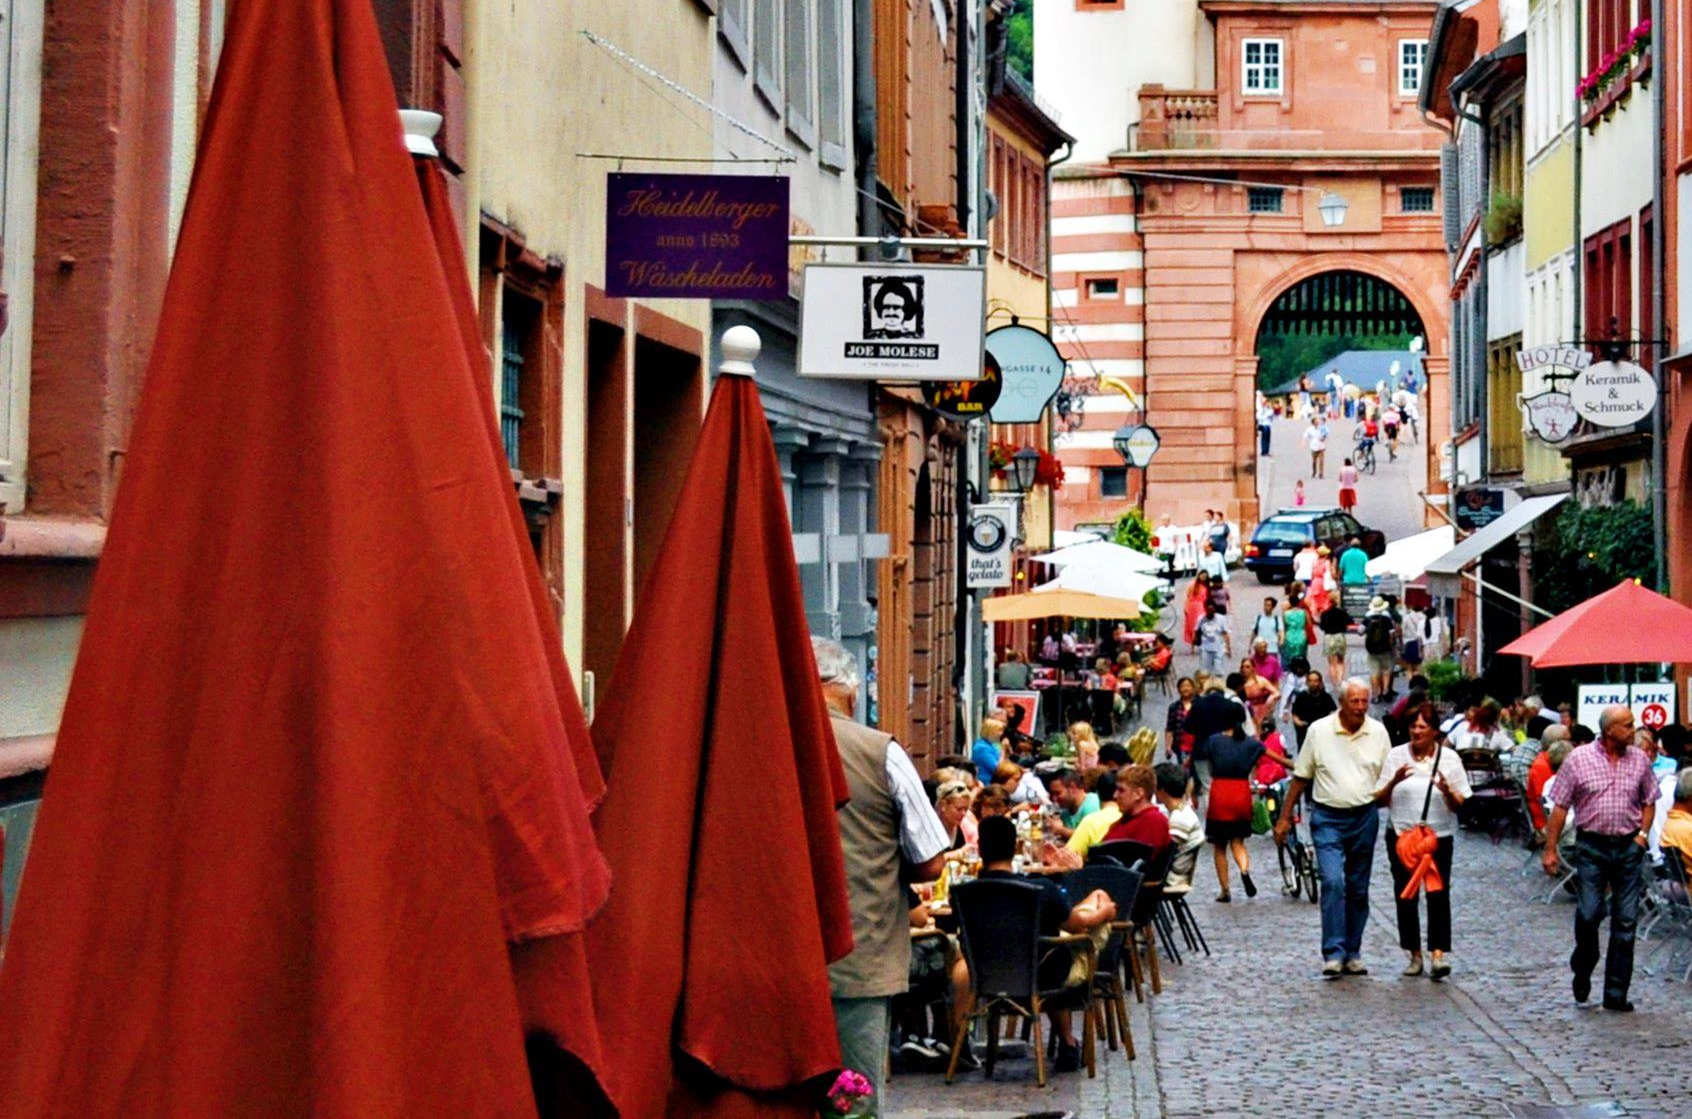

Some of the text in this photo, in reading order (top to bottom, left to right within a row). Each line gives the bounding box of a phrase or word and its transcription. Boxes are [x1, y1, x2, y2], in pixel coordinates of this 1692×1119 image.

[617, 189, 779, 229] Heidelberger
[656, 235, 694, 248] anno
[620, 260, 777, 289] Wäscheladen
[847, 345, 936, 358] JOE MOLESE
[1520, 347, 1587, 370] HOTEL
[1001, 365, 1035, 373] GASSE
[1585, 373, 1641, 386] Keramik
[1608, 388, 1619, 399] &
[1584, 400, 1645, 414] Schmuck
[971, 557, 1001, 569] that's
[969, 569, 1004, 583] gelato
[1644, 708, 1664, 725] 36
